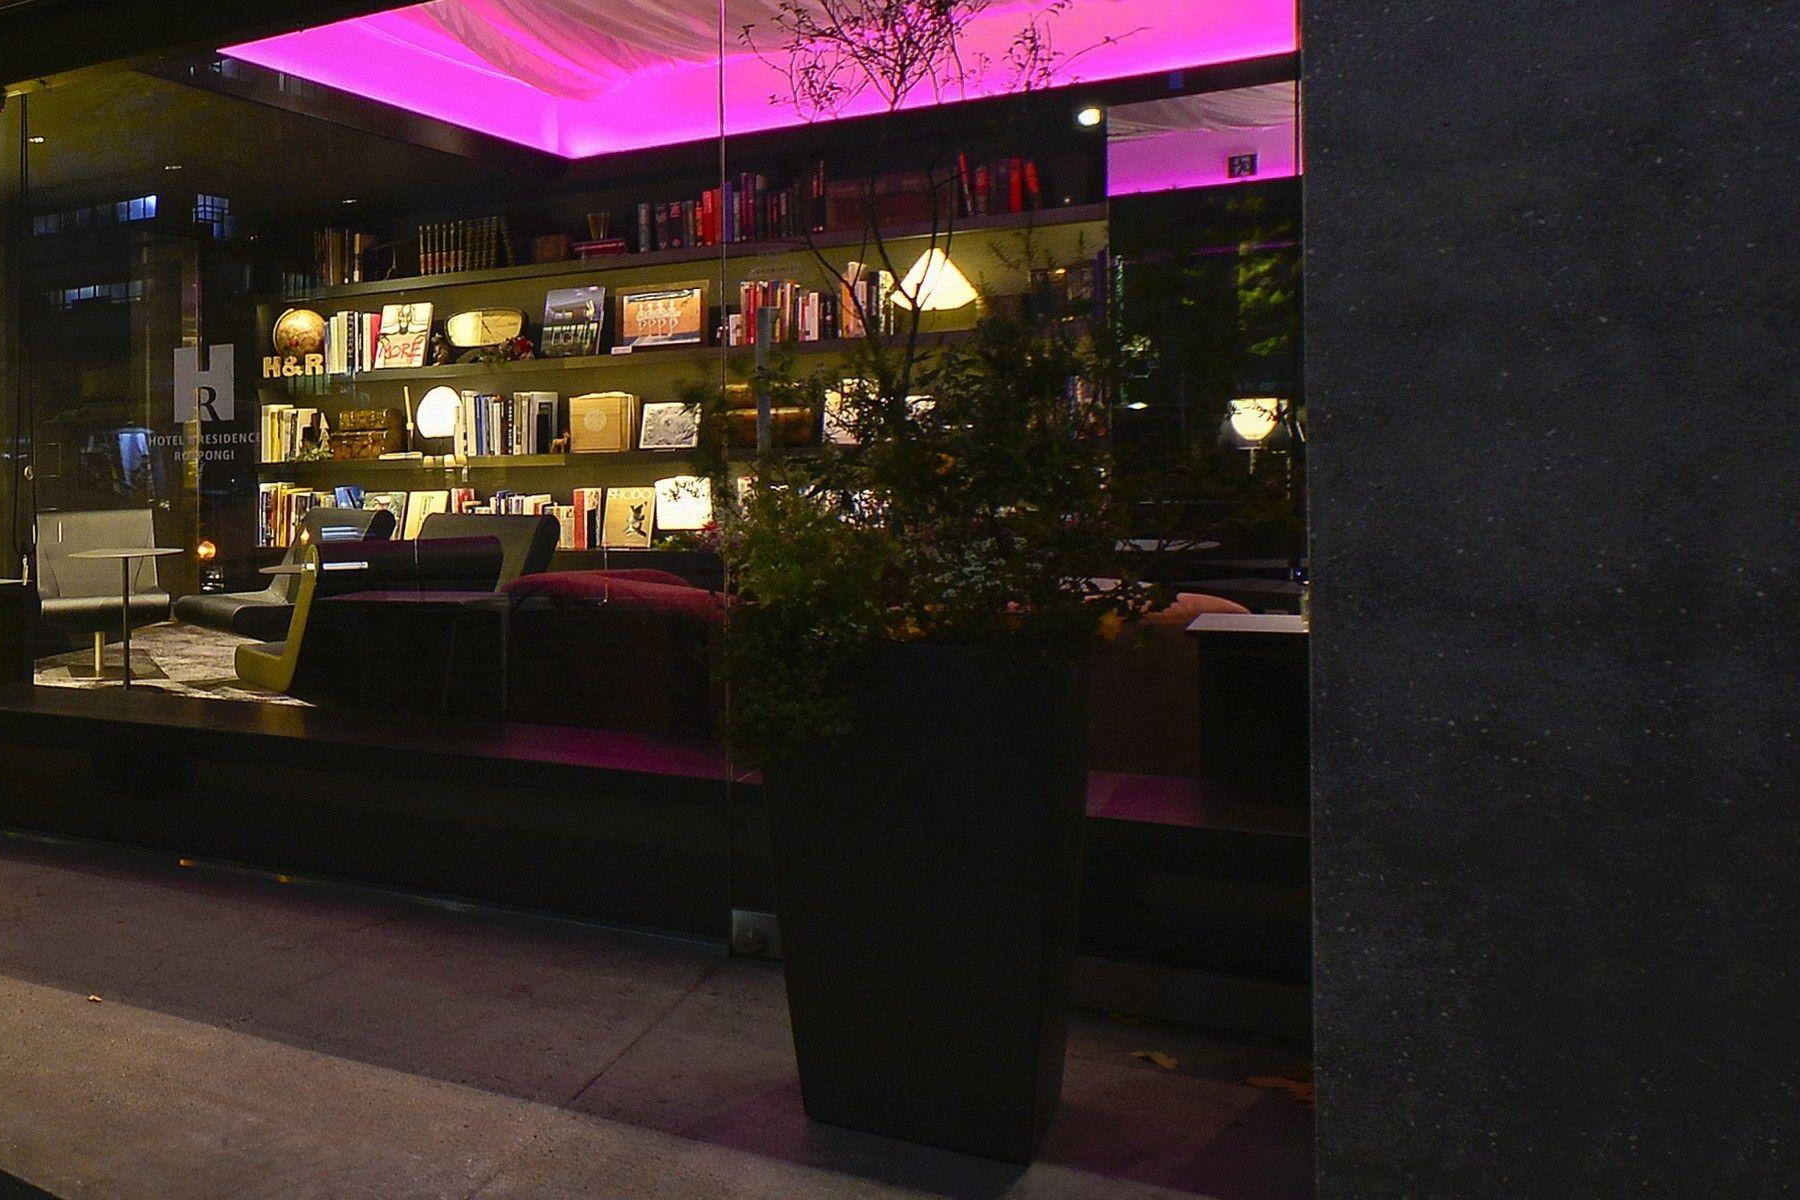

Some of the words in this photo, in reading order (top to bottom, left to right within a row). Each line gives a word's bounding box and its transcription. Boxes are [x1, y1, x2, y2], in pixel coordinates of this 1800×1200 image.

[262, 352, 324, 378] H&R
[149, 434, 184, 447] HOTEL
[174, 449, 235, 461] ROPONGI
